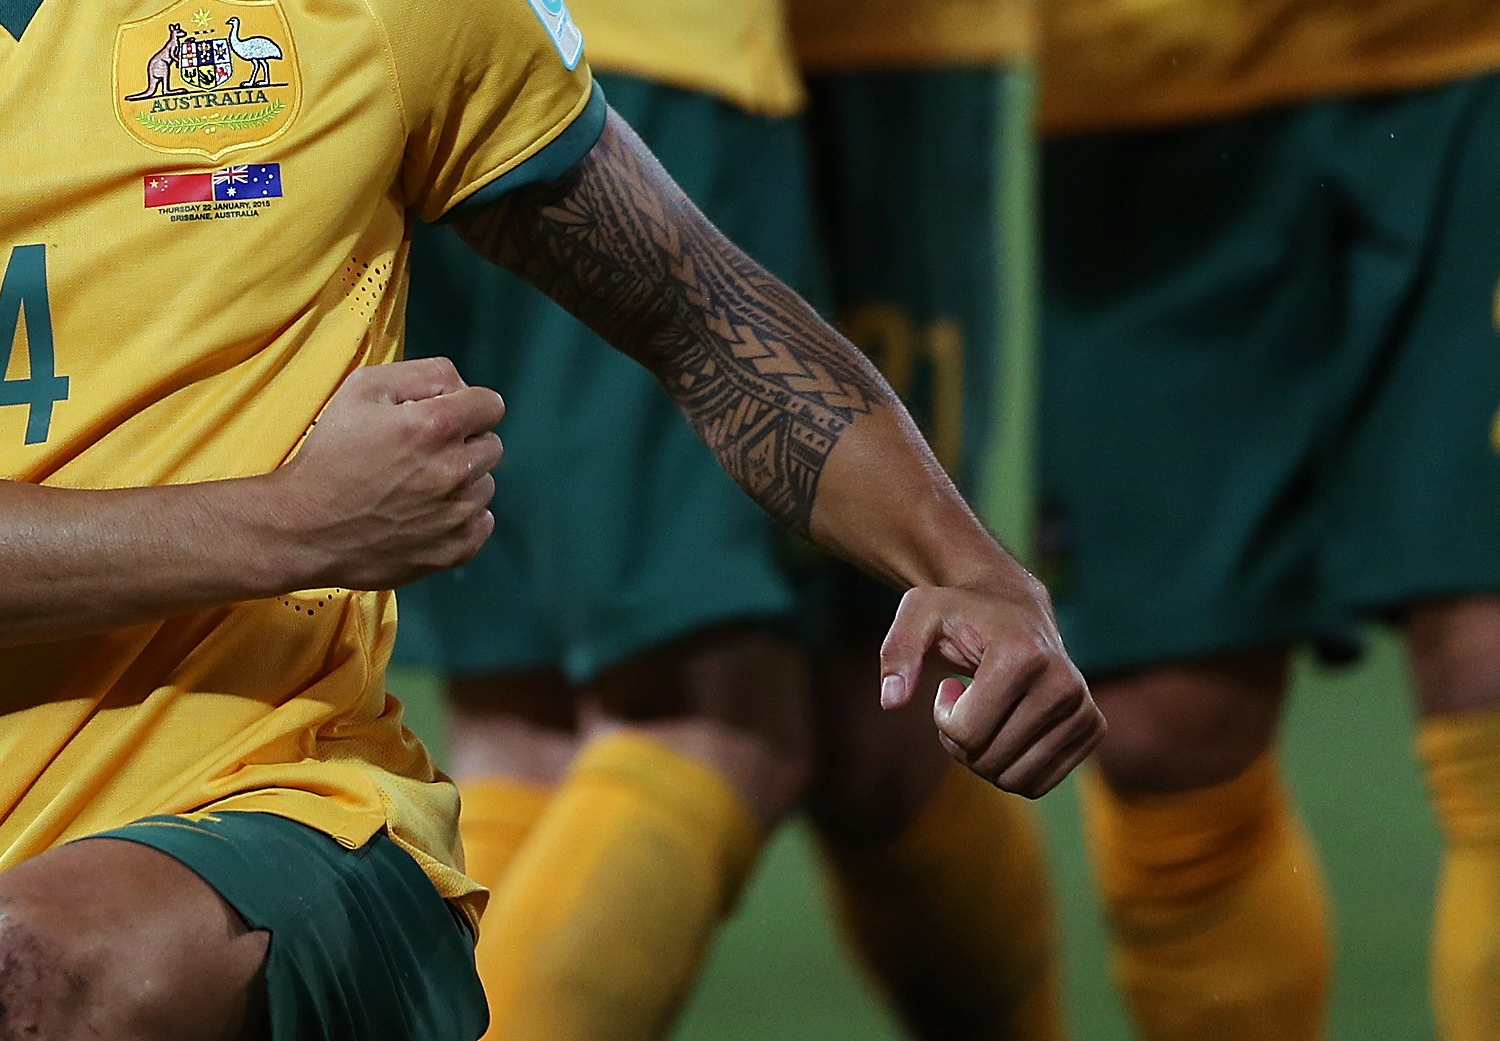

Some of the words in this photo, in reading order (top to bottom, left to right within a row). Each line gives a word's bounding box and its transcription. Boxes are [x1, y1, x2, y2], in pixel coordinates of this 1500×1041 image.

[150, 90, 269, 114] AUSTRALIA
[158, 204, 200, 214] THURSDAY
[252, 200, 271, 208] 2015
[170, 211, 213, 222] BRISBANE,
[214, 209, 259, 220] AUSTRALIA
